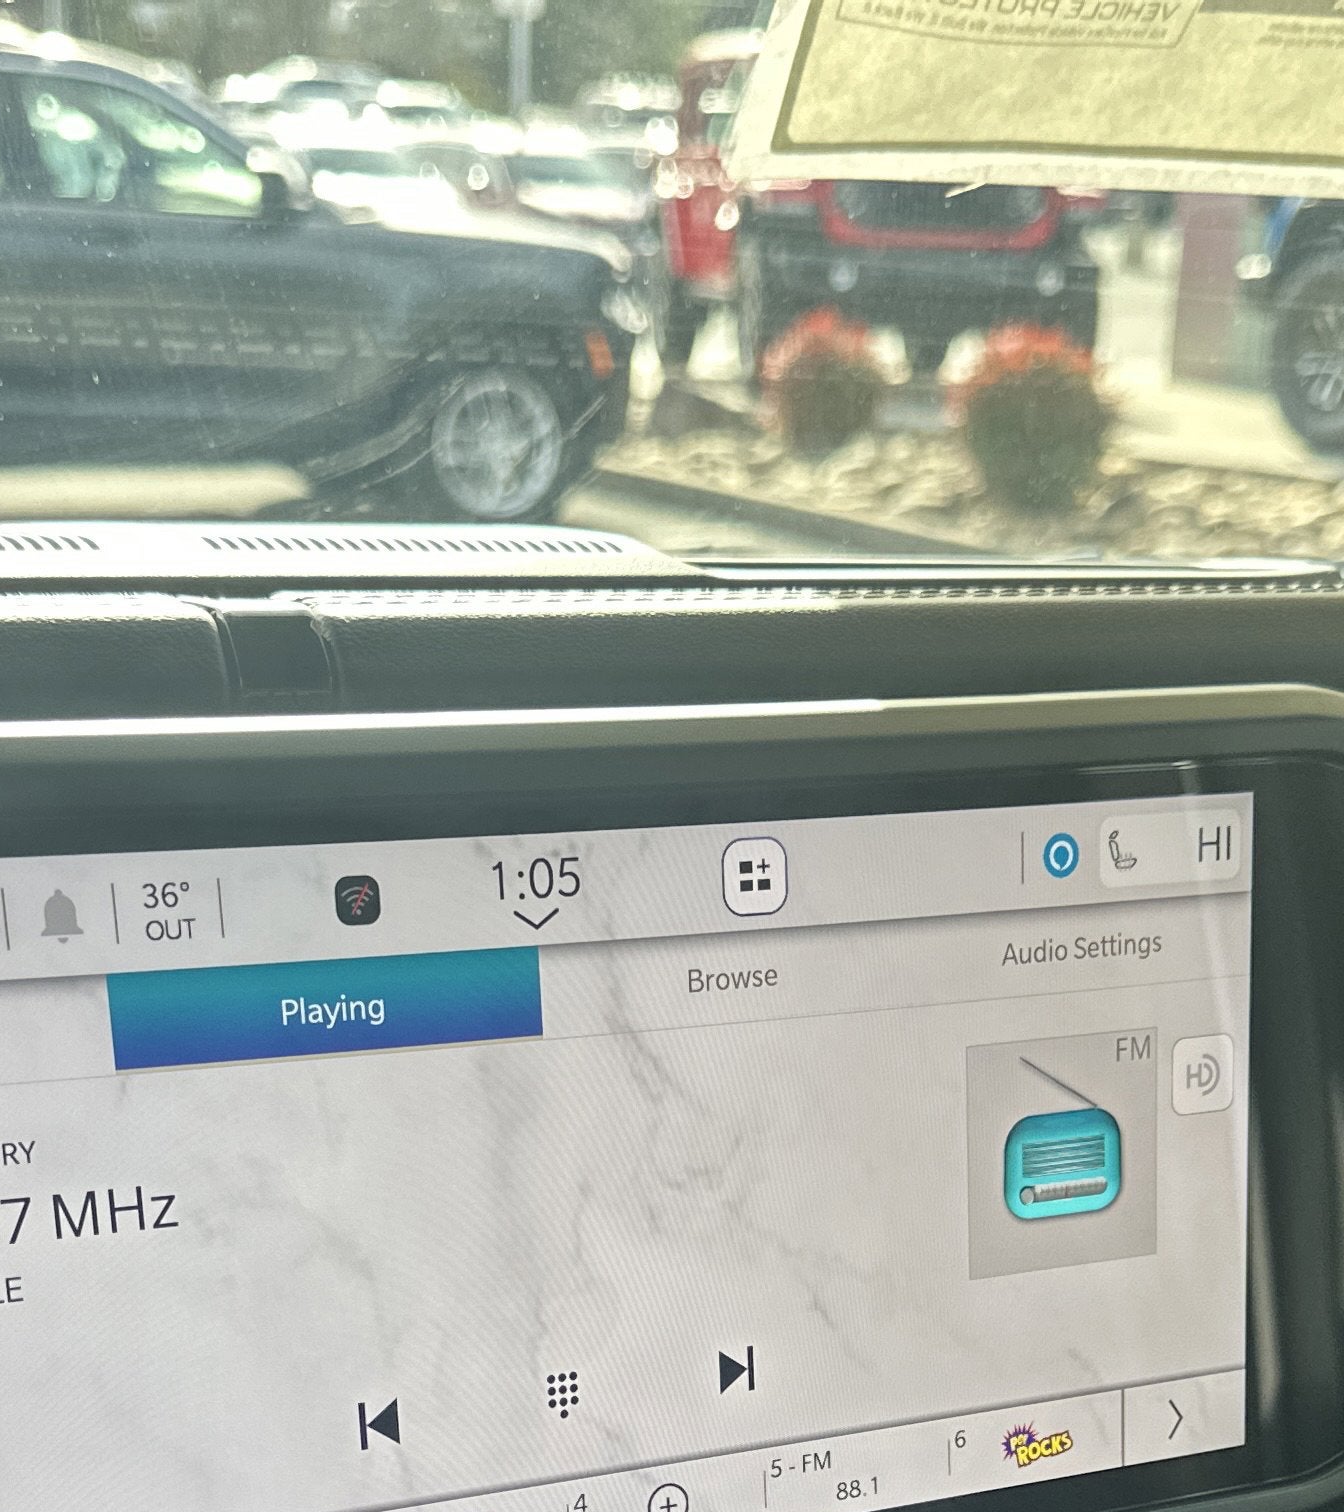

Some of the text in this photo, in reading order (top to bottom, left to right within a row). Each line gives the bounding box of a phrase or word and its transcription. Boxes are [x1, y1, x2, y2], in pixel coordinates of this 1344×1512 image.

[1197, 825, 1232, 864] HI
[141, 880, 191, 909] 36°
[490, 856, 582, 903] 1:05
[146, 916, 197, 942] OUT
[1001, 931, 1162, 967] Audio Settings
[687, 964, 779, 994] Browse
[281, 995, 386, 1029] Playing
[1115, 1035, 1152, 1063] FM
[51, 1185, 180, 1240] MHz
[955, 1430, 967, 1451] 6
[1016, 1430, 1074, 1468] ROCKS
[770, 1458, 782, 1478] 5
[801, 1451, 833, 1474] FM
[836, 1477, 880, 1501] 88.1
